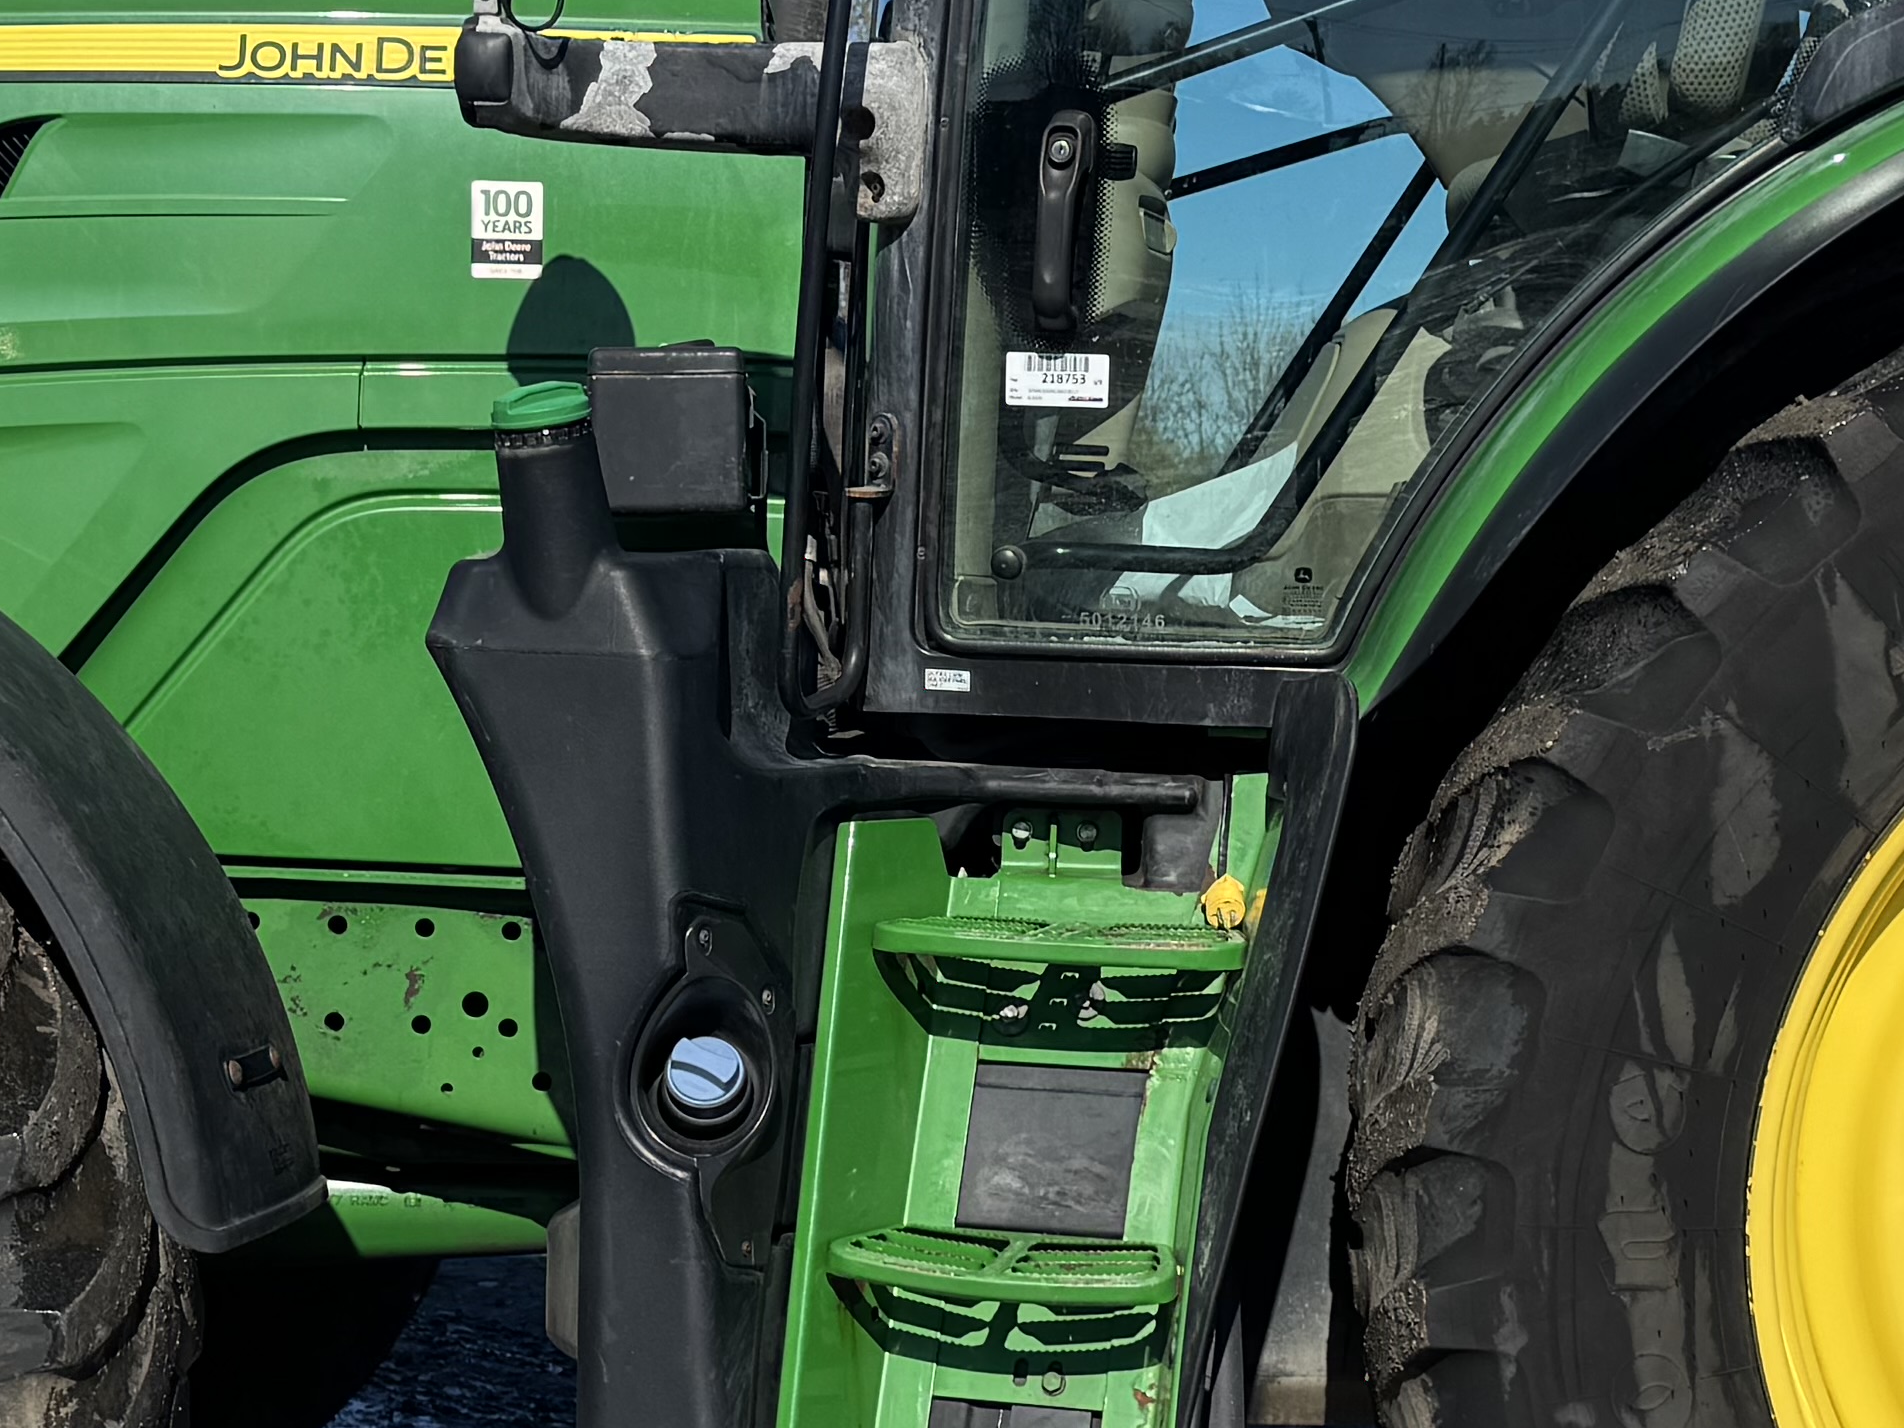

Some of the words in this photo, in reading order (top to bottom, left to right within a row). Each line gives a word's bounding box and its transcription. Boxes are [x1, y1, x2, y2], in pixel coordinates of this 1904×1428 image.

[218, 33, 363, 74] JOHN
[480, 189, 533, 219] 100
[480, 219, 533, 234] YEARS
[1041, 373, 1087, 385] 218753
